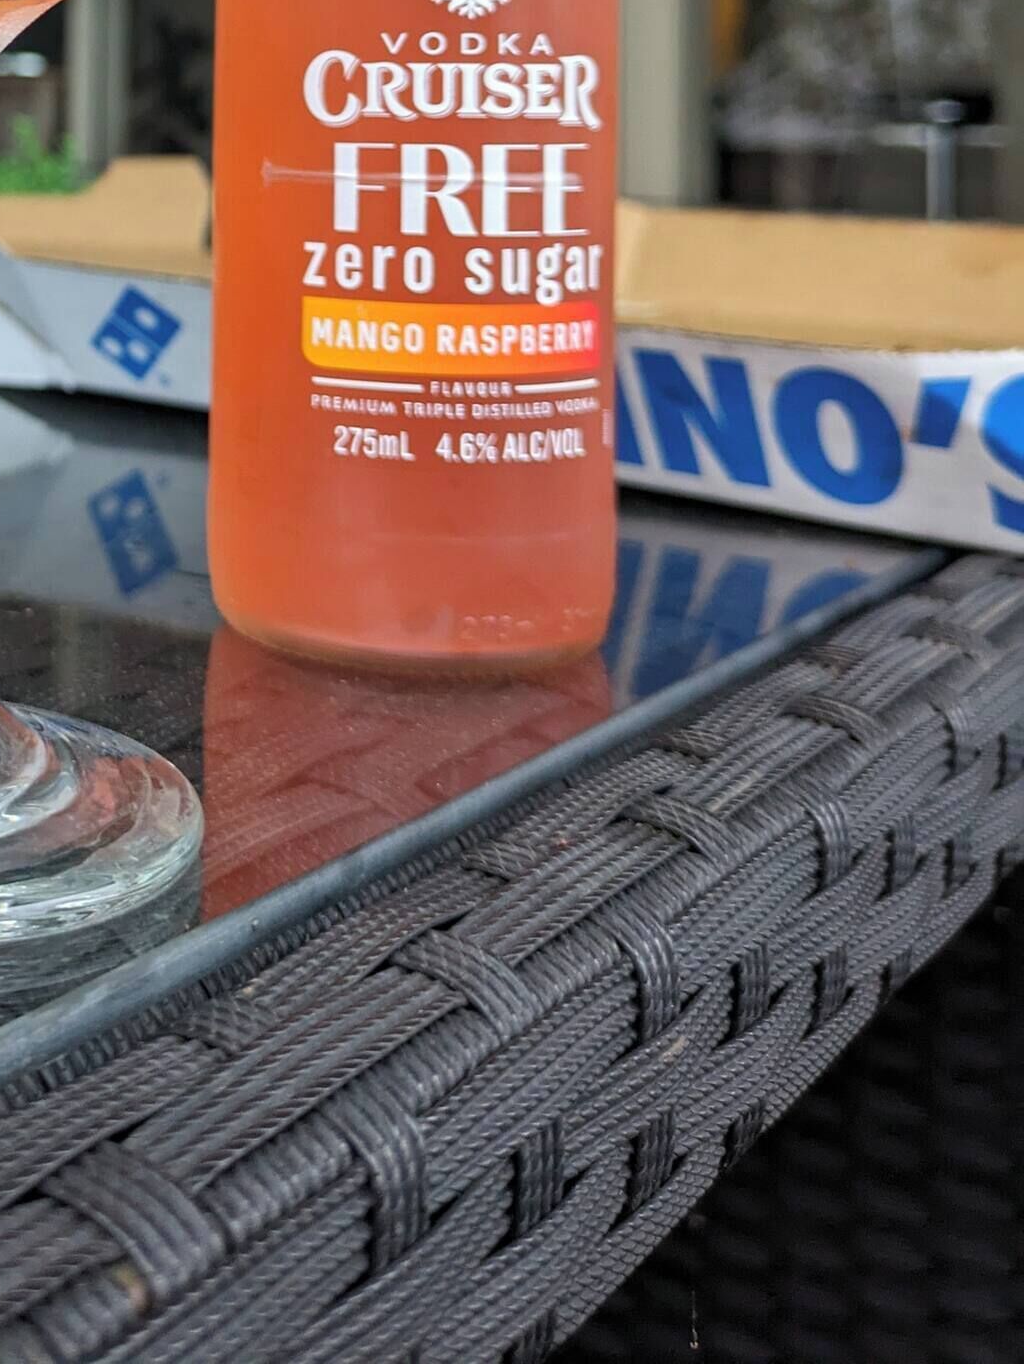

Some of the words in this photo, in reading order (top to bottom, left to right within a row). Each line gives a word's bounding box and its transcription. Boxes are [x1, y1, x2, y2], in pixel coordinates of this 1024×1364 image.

[381, 32, 555, 56] VODKA
[303, 49, 603, 131] CRUISER
[333, 142, 590, 237] FREE
[302, 240, 436, 294] zero
[464, 242, 604, 306] sugar
[311, 316, 425, 354] MANGO
[436, 320, 597, 356] RASPBERRY
[310, 393, 397, 416] PREMIUM
[403, 400, 466, 419] TRIPLE
[471, 401, 554, 421] DISTILLED
[429, 380, 514, 398] FLAVOUR
[333, 424, 416, 462] 275mL
[436, 431, 497, 465] 4.6%
[502, 426, 587, 462] ALC/VOL
